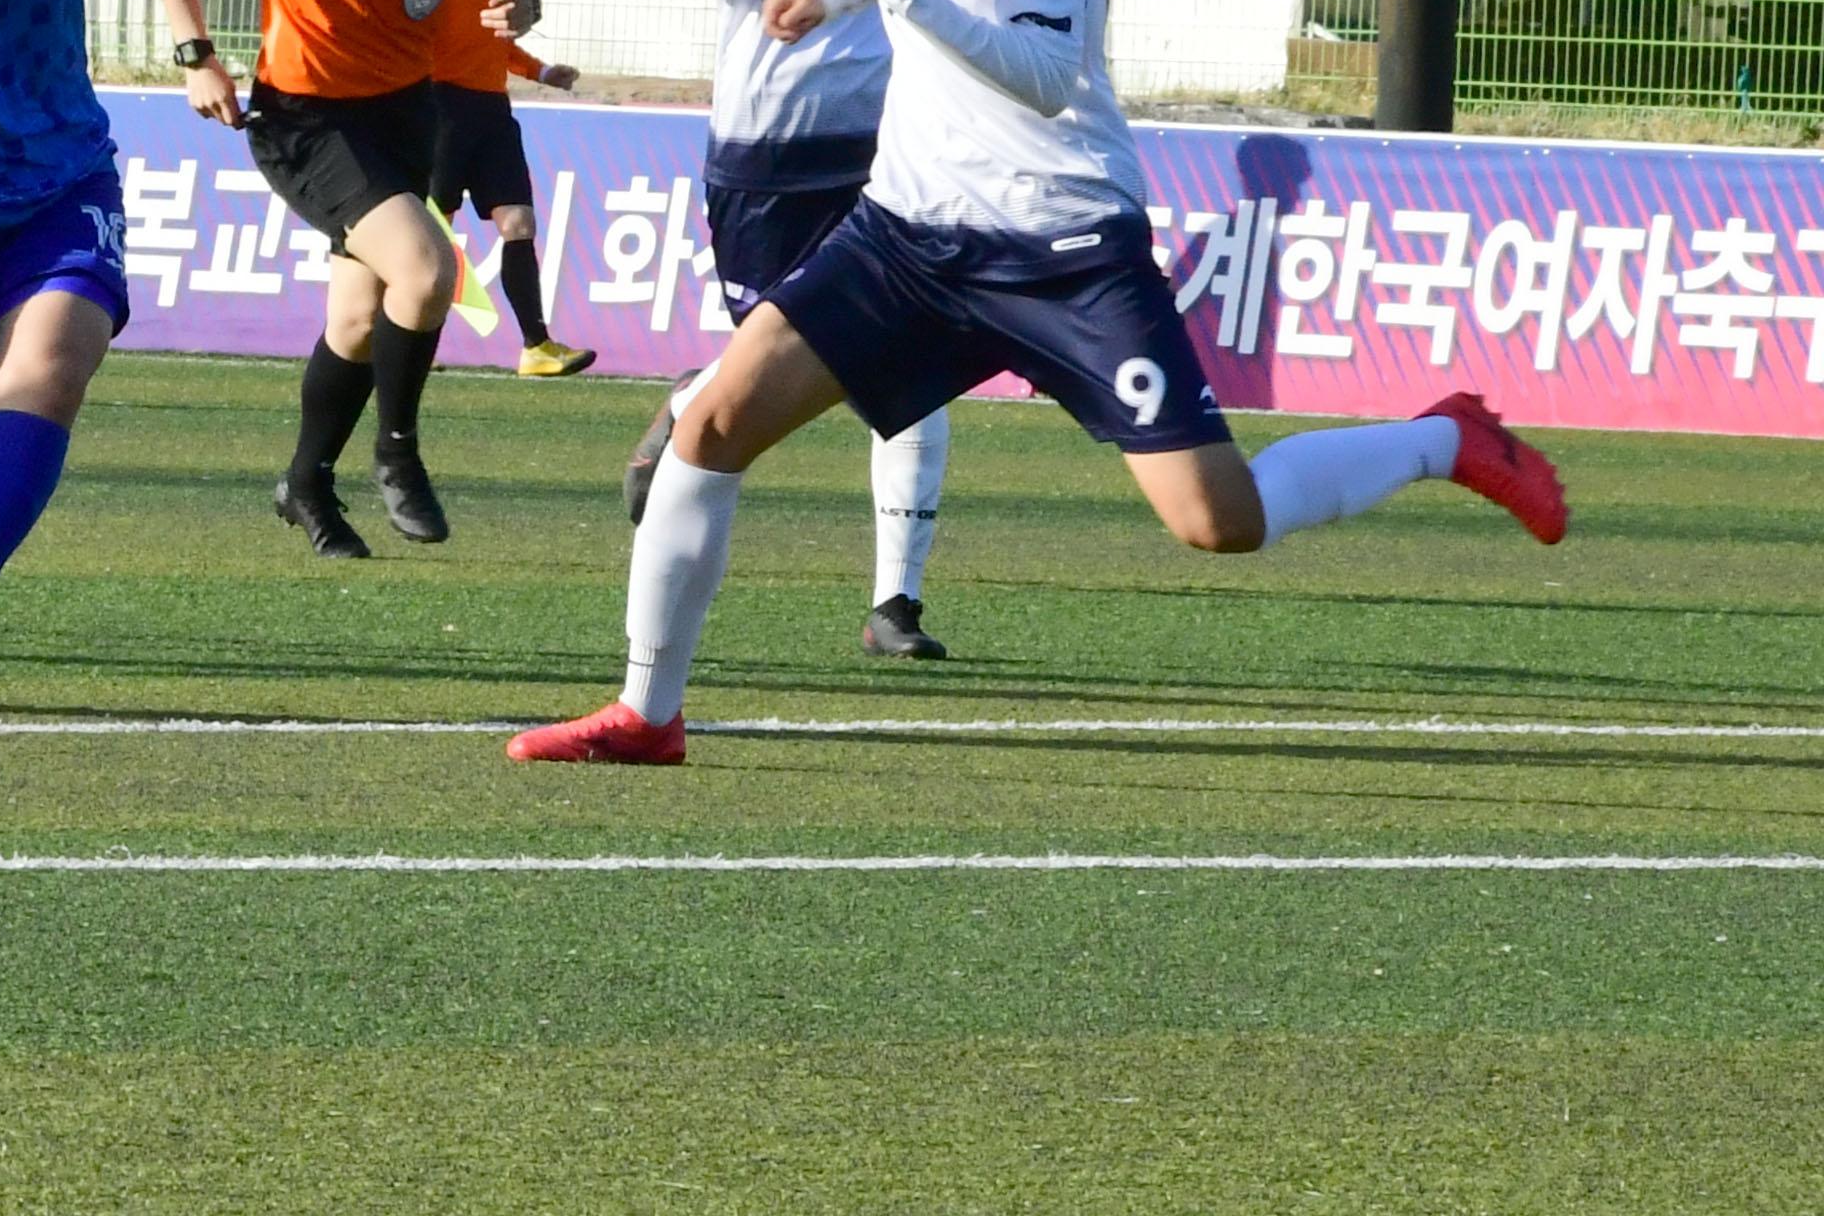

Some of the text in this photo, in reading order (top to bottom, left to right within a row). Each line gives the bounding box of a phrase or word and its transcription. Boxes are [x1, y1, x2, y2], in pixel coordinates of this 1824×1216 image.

[588, 176, 734, 333] 화
[1144, 197, 1824, 384] 계한국여자축
[1114, 357, 1167, 427] 9
